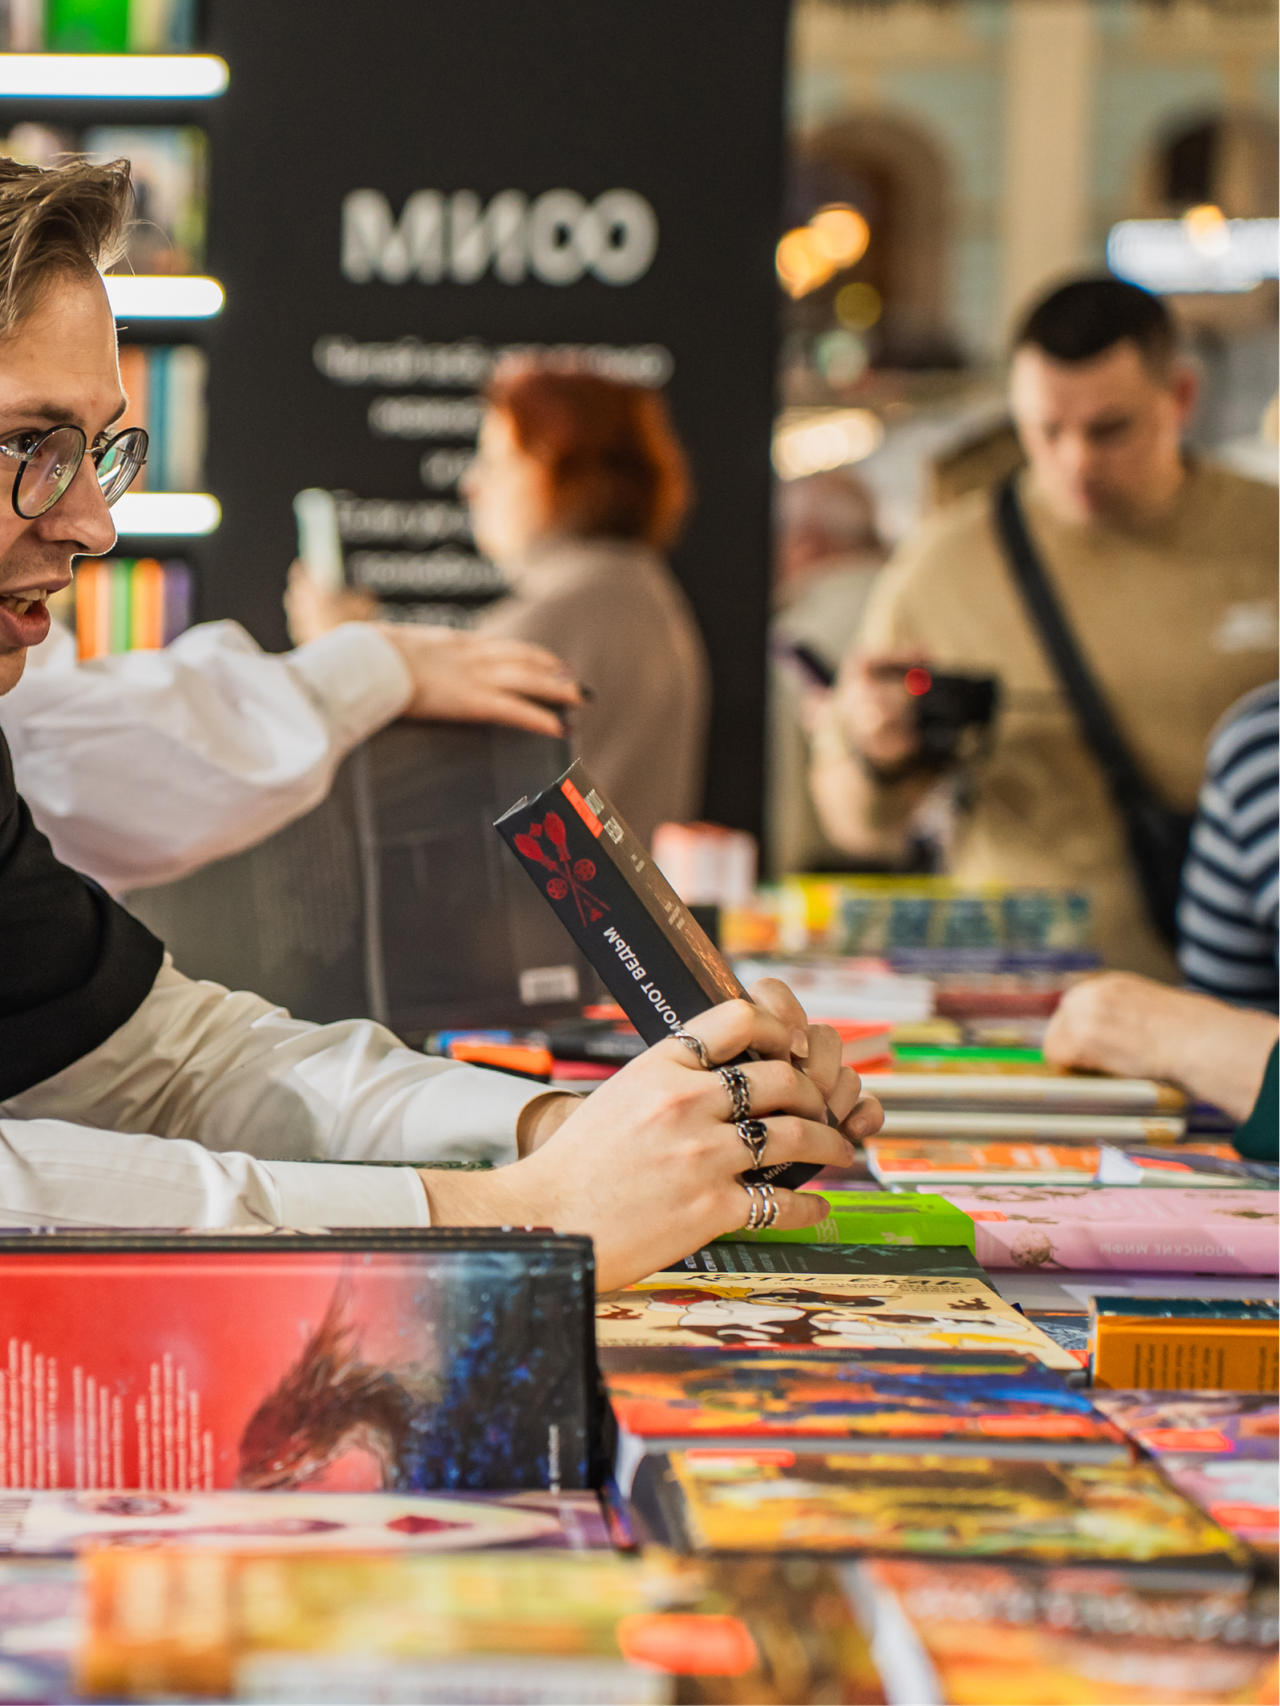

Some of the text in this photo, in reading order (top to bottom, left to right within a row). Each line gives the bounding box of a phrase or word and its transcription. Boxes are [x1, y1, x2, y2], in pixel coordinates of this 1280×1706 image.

[603, 926, 647, 980] ВЕДЬМ
[1099, 1243, 1235, 1257] ЯПОНСКИЕ МИФЫ
